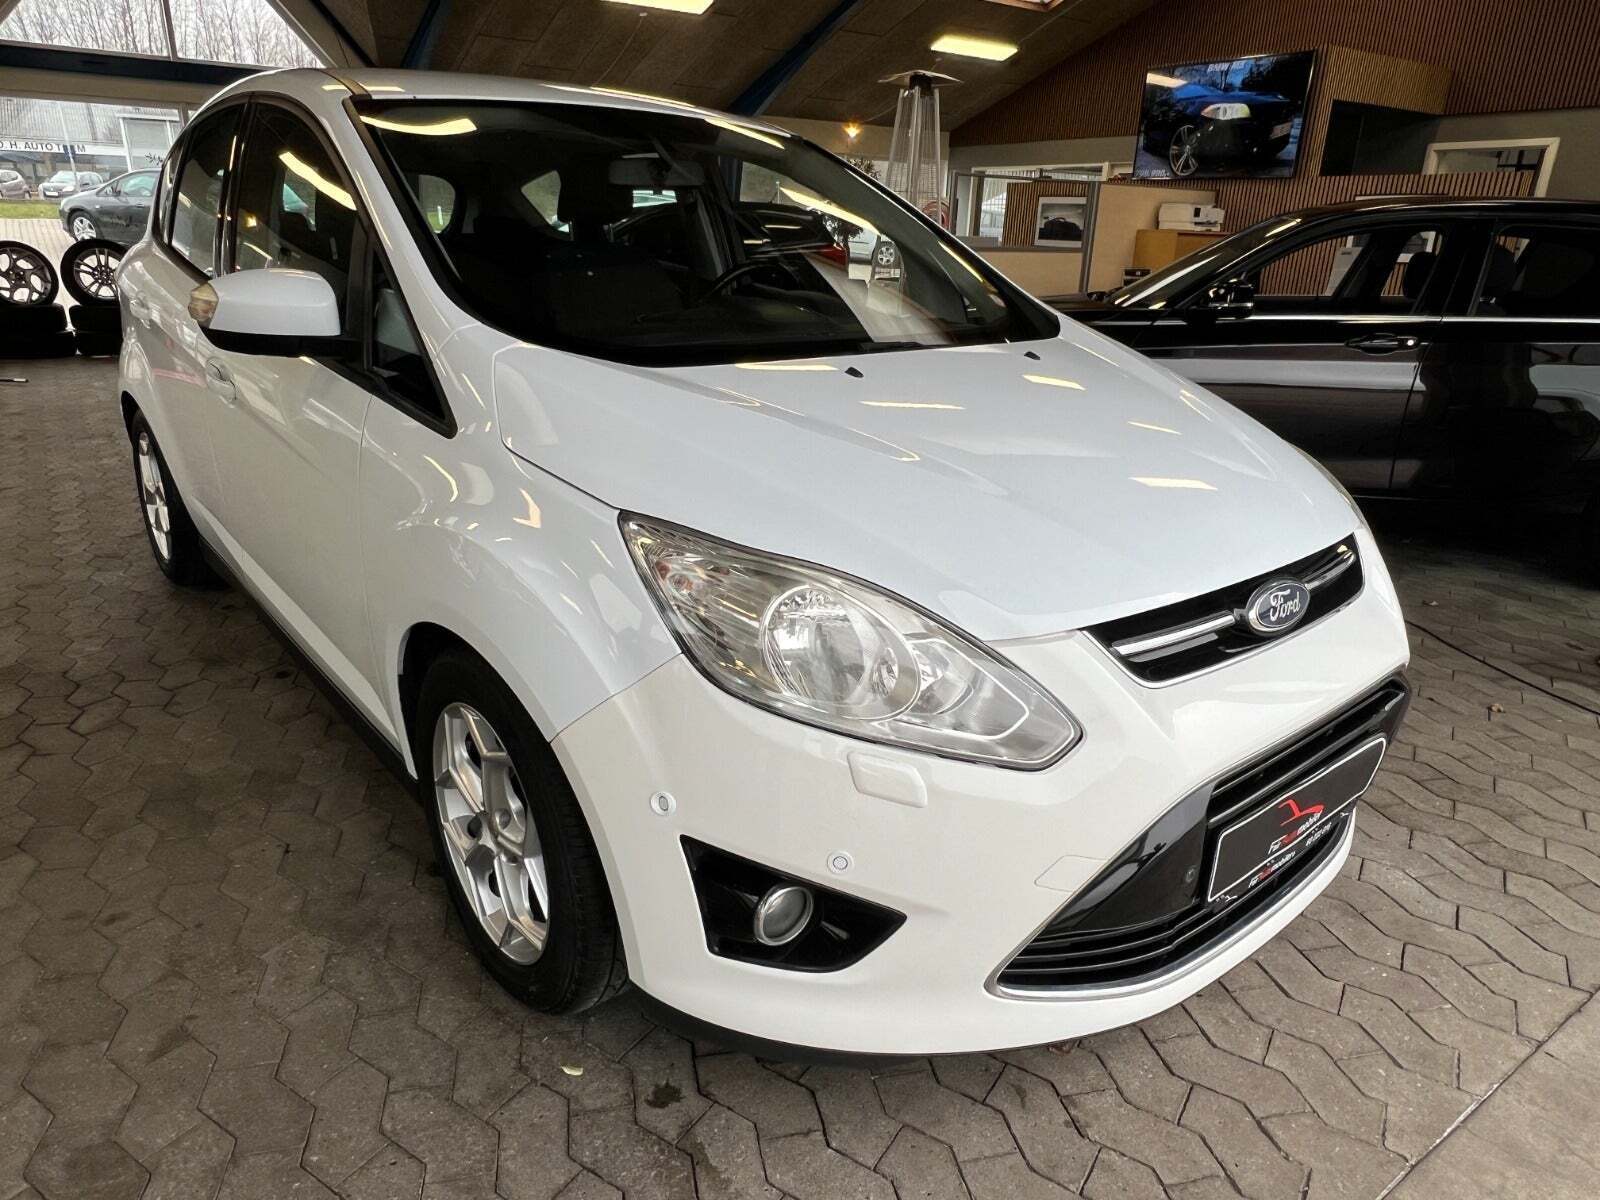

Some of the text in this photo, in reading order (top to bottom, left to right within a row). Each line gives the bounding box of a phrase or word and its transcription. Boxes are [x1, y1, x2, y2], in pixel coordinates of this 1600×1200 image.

[24, 141, 53, 151] AUTO
[57, 143, 86, 153] TM
[1270, 589, 1300, 621] Ford
